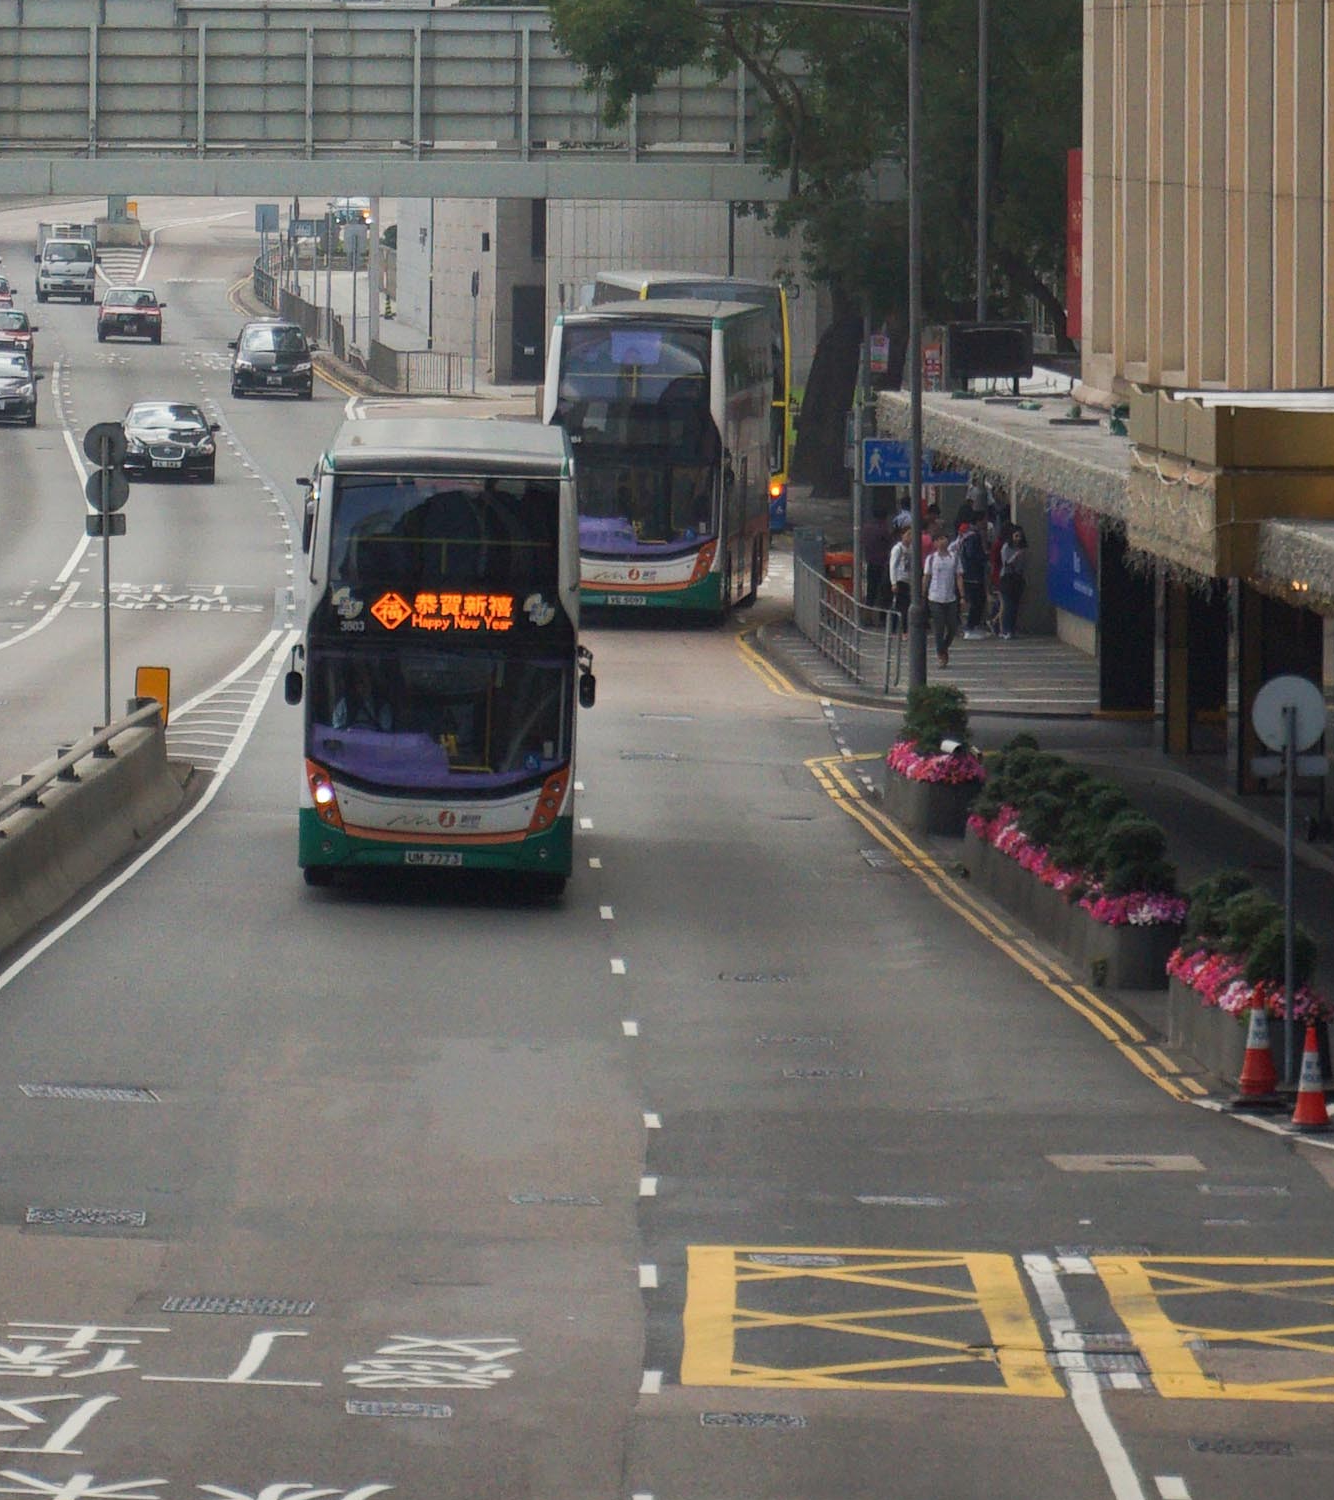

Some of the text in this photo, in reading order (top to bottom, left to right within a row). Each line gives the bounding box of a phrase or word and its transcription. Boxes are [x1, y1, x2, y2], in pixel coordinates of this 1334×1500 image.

[414, 593, 514, 618] 恭賀新禧
[411, 615, 513, 631] Happy New Year
